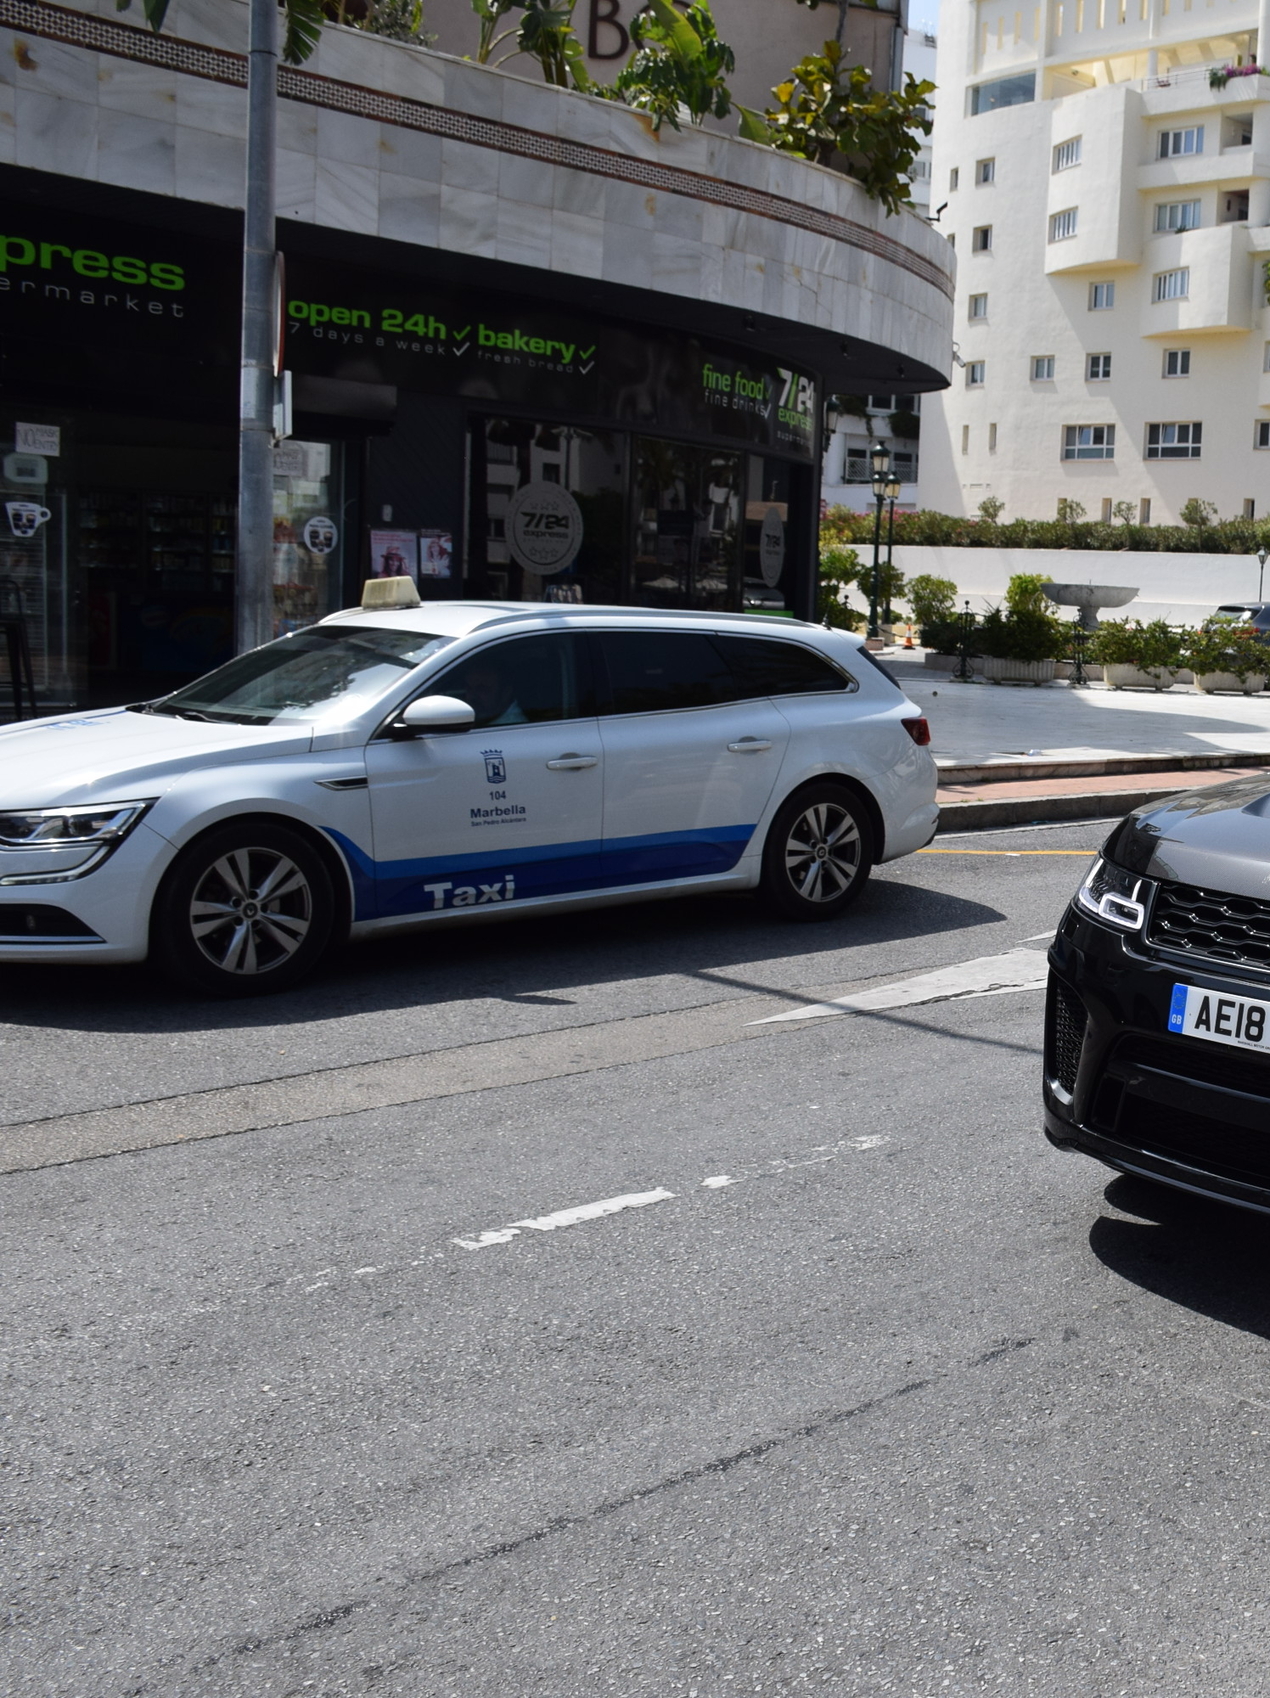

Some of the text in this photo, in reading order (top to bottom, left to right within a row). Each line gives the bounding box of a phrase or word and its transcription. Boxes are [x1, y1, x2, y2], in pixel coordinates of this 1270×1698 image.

[288, 300, 446, 340] open 24h
[288, 321, 446, 355] 7 days a week
[478, 324, 575, 363] bakery
[477, 351, 574, 374] fresh bread
[703, 363, 765, 400] fine food
[777, 367, 815, 414] 7/24
[705, 389, 728, 407] fine
[521, 512, 569, 530] 7/24
[523, 530, 569, 539] express
[489, 791, 507, 801] 104
[470, 805, 526, 819] Marbella
[424, 875, 515, 910] Taxi
[1171, 1013, 1182, 1025] GB
[1194, 995, 1265, 1043] AE18
